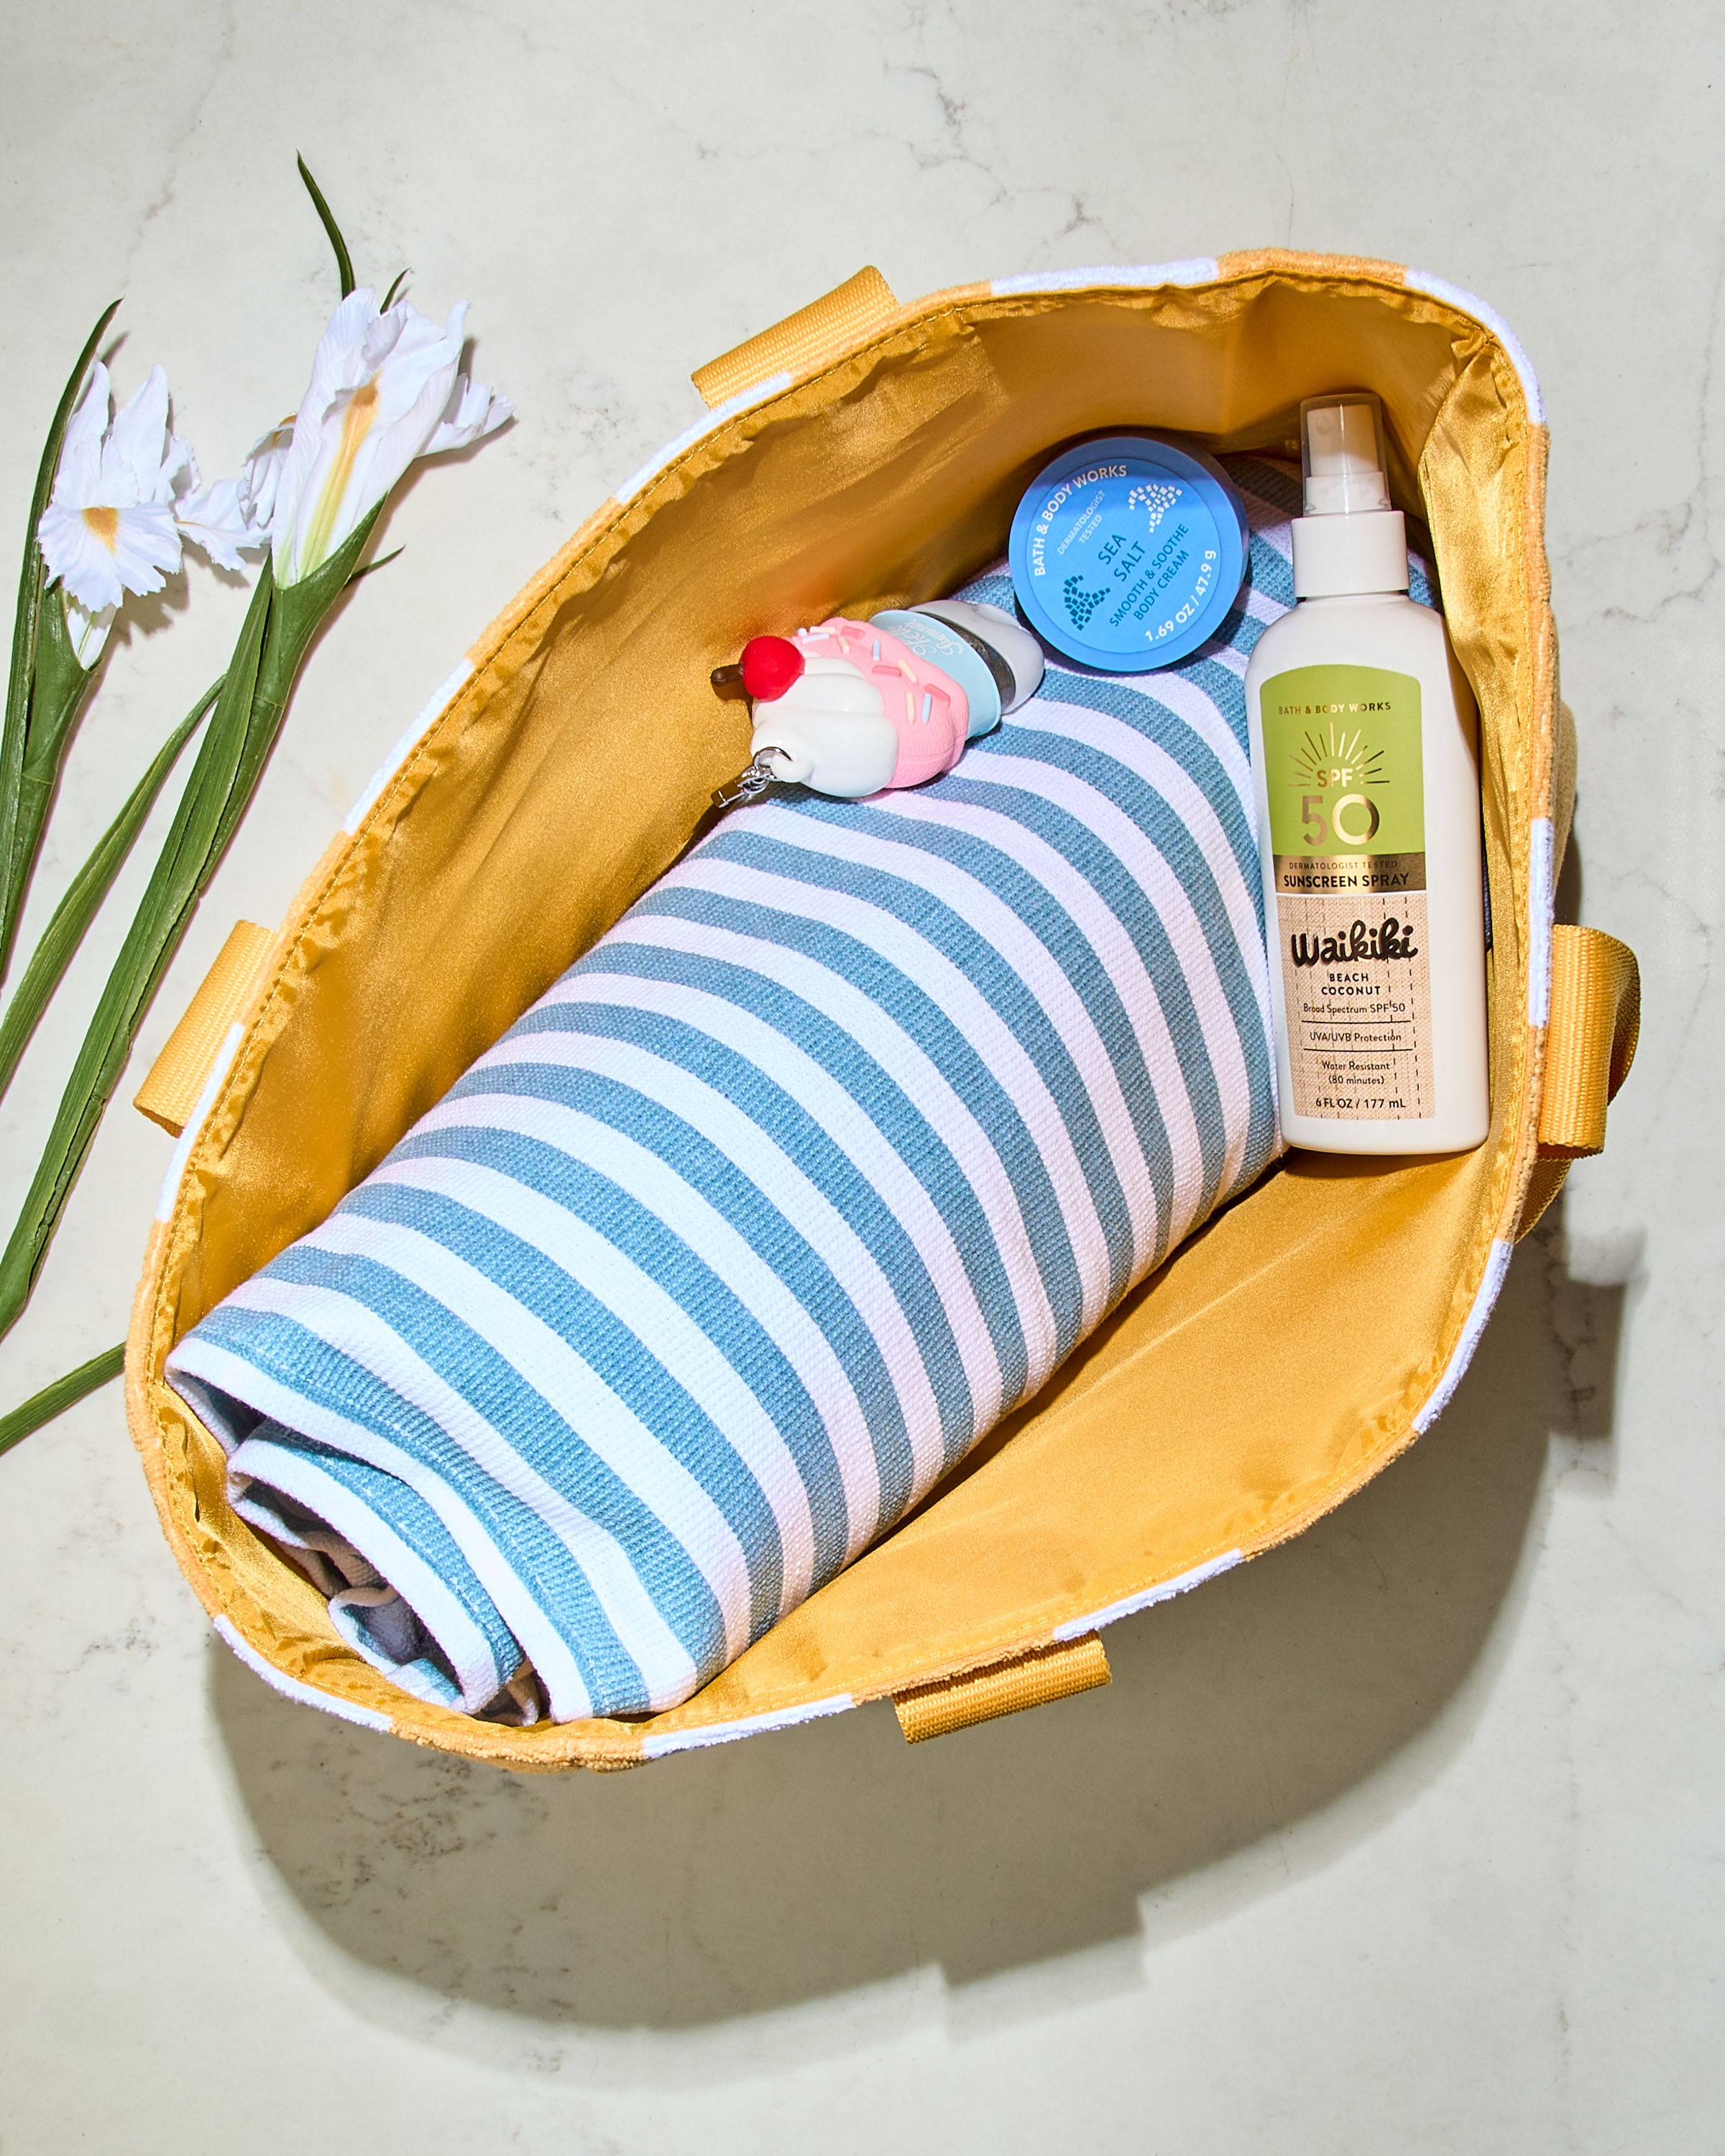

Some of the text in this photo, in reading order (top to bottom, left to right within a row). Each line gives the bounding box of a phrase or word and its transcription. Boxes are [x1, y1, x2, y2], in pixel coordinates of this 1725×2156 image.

[1032, 465, 1128, 576] BATH & BODY WORKS
[1057, 490, 1105, 556] DERMATOLOGIST
[1079, 514, 1103, 544] TESTED
[1098, 533, 1127, 565] SEA
[1114, 540, 1146, 581] SALT
[1110, 524, 1188, 627] SMOOTH & SOOTHE
[1133, 550, 1190, 621] BODY CREAM
[1145, 620, 1174, 642] 1.69
[1175, 604, 1195, 624] OZ
[1195, 563, 1212, 596] 47.9
[1205, 550, 1217, 560] g
[1279, 706, 1301, 714] BATH
[1315, 704, 1344, 714] BODY
[1349, 702, 1391, 713] WORKS
[1317, 768, 1353, 788] SPF
[1302, 793, 1379, 846] 50
[1363, 860, 1397, 869] TESTED
[1284, 873, 1409, 888] SUNSCREEN SPRAY
[1291, 917, 1418, 967] Waikiki
[1330, 973, 1368, 982] BEACH
[1321, 986, 1380, 995] COCONUT
[1303, 1003, 1405, 1016] Broad Spectrum SPF 50
[1310, 1033, 1402, 1042] UVA/UVB Protection
[1322, 1061, 1390, 1070] Water Resistant
[1329, 1076, 1384, 1084] (80 minutes)
[1315, 1098, 1406, 1108] 6 FL OZ / 177 mL
